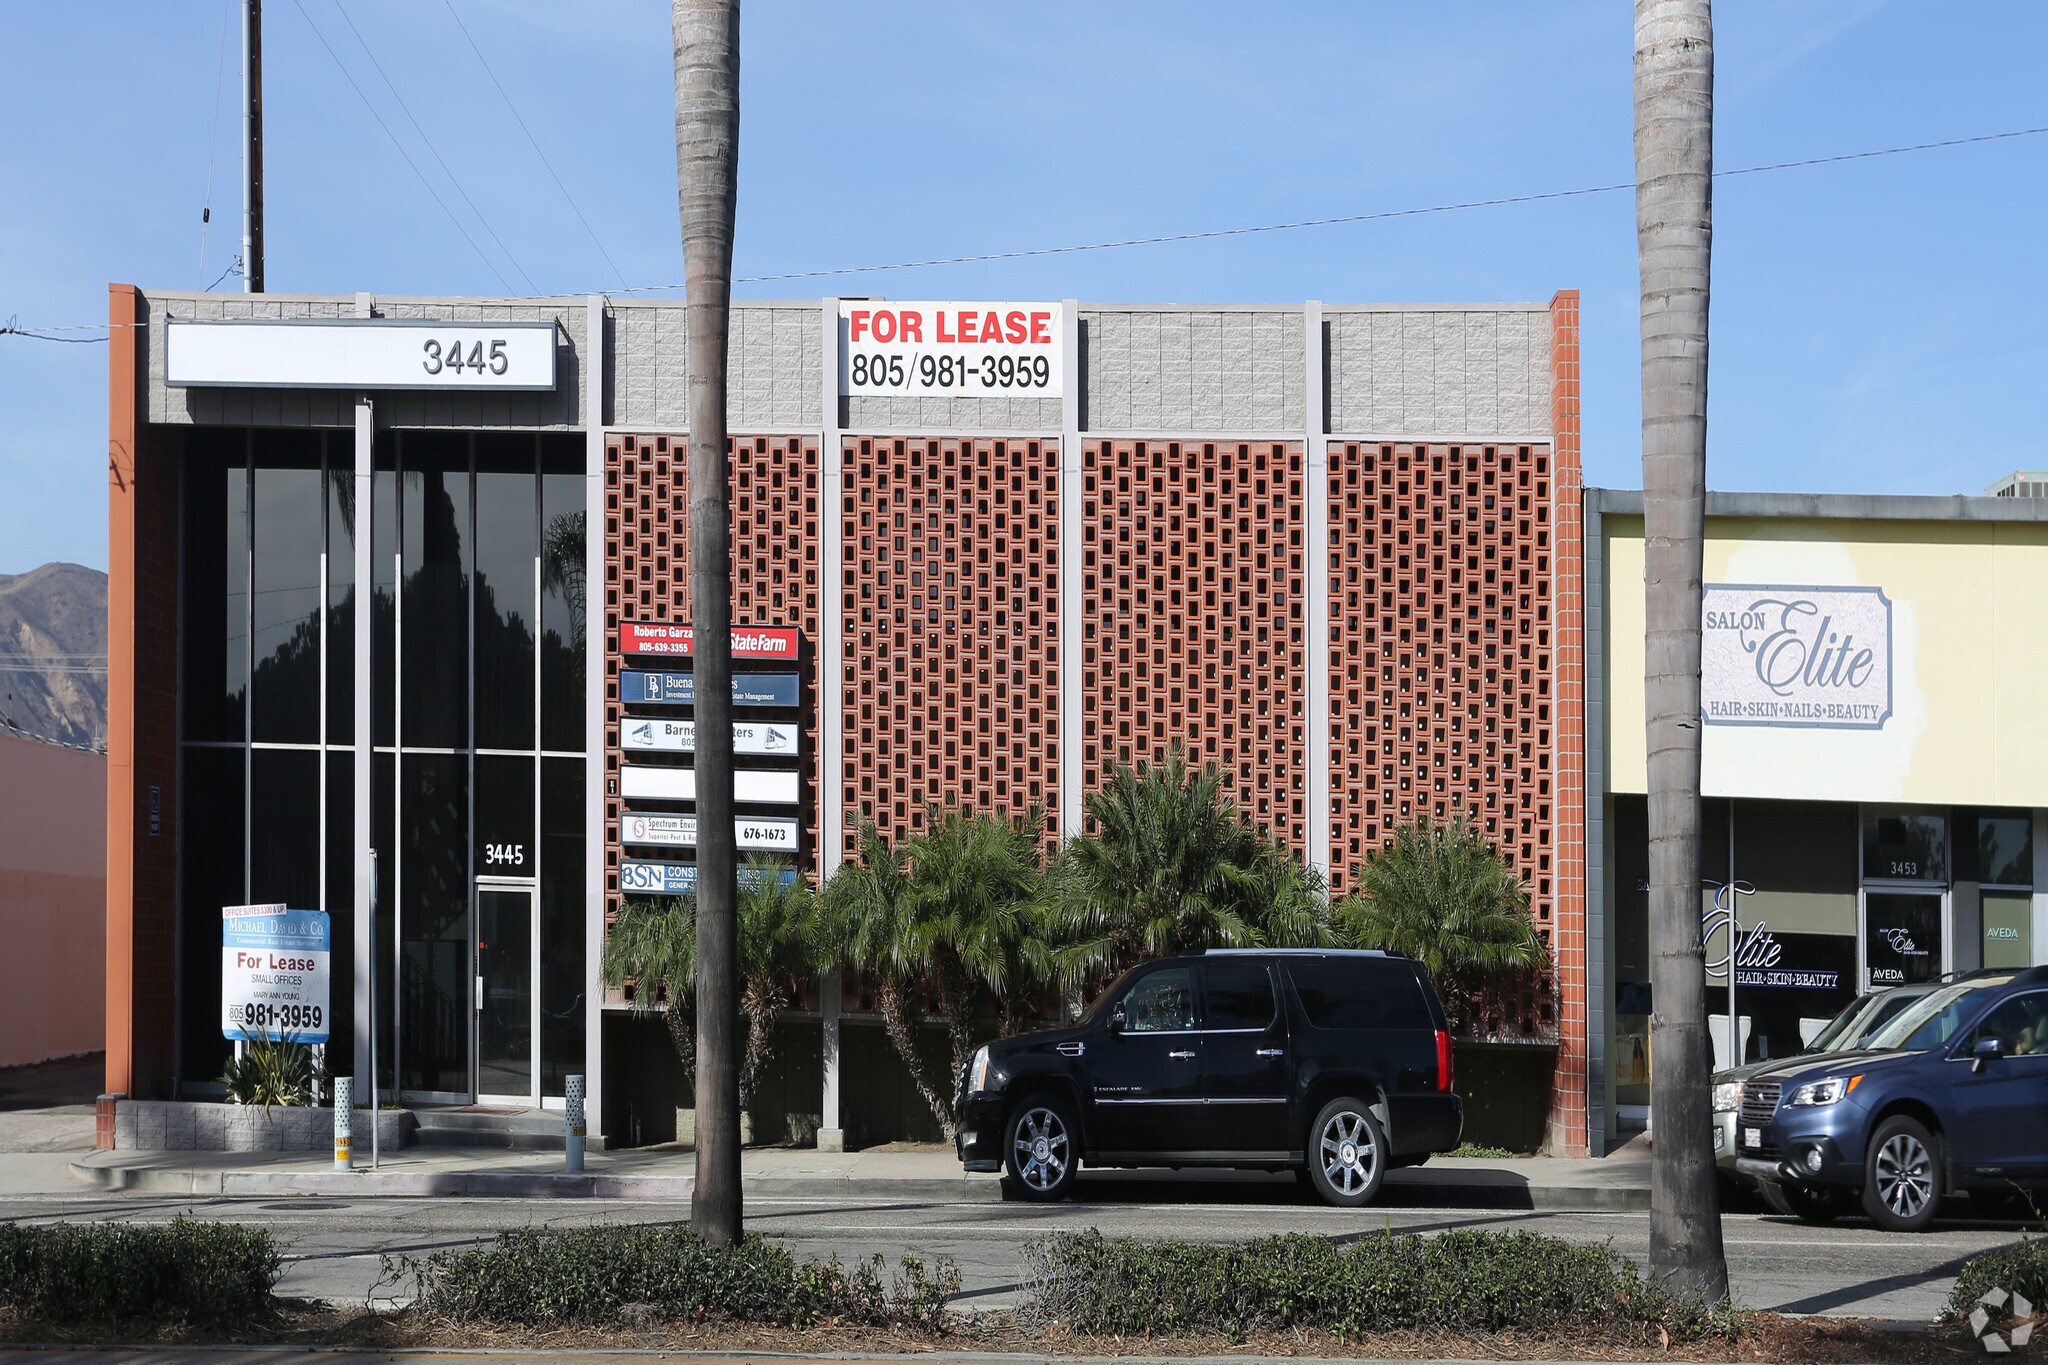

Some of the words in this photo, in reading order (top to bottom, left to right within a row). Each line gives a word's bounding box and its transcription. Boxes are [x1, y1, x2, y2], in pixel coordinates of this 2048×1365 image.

[851, 310, 923, 343] FOR
[936, 311, 1051, 344] LEASE
[423, 339, 508, 375] 3445
[852, 352, 1050, 389] 805/981-3959
[1706, 611, 1766, 630] SALON
[634, 625, 667, 638] Roberto
[669, 626, 693, 638] Garza
[639, 642, 688, 652] 805-639-3355
[1741, 599, 1874, 697] Elite
[666, 675, 693, 688] Buena
[1710, 701, 1742, 716] HAIR
[1748, 702, 1783, 717] SKIN
[1784, 703, 1821, 718] NAILS
[1827, 704, 1879, 720] BEAUTY
[665, 724, 696, 736] Barne
[648, 818, 678, 830] Spectrum
[743, 827, 786, 840] 676-1673
[485, 843, 524, 865] 3445
[621, 864, 662, 888] BSN
[1891, 862, 1917, 876] 3453
[225, 908, 242, 917] OFFICE
[243, 907, 260, 915] SUITES
[261, 905, 272, 914] $300
[278, 905, 285, 913] UP
[237, 952, 262, 968] For
[269, 953, 315, 971] Lease
[251, 973, 273, 984] SMALL
[274, 974, 302, 986] OFFICES
[1736, 971, 1764, 985] HAIR
[1766, 972, 1793, 986] SKIN
[1794, 973, 1838, 987] BEAUTY
[253, 991, 268, 999] MARY
[269, 992, 281, 1000] ANN
[281, 992, 300, 1001] YOUNG
[229, 1007, 243, 1019] 805
[245, 1003, 322, 1028] 981-3959
